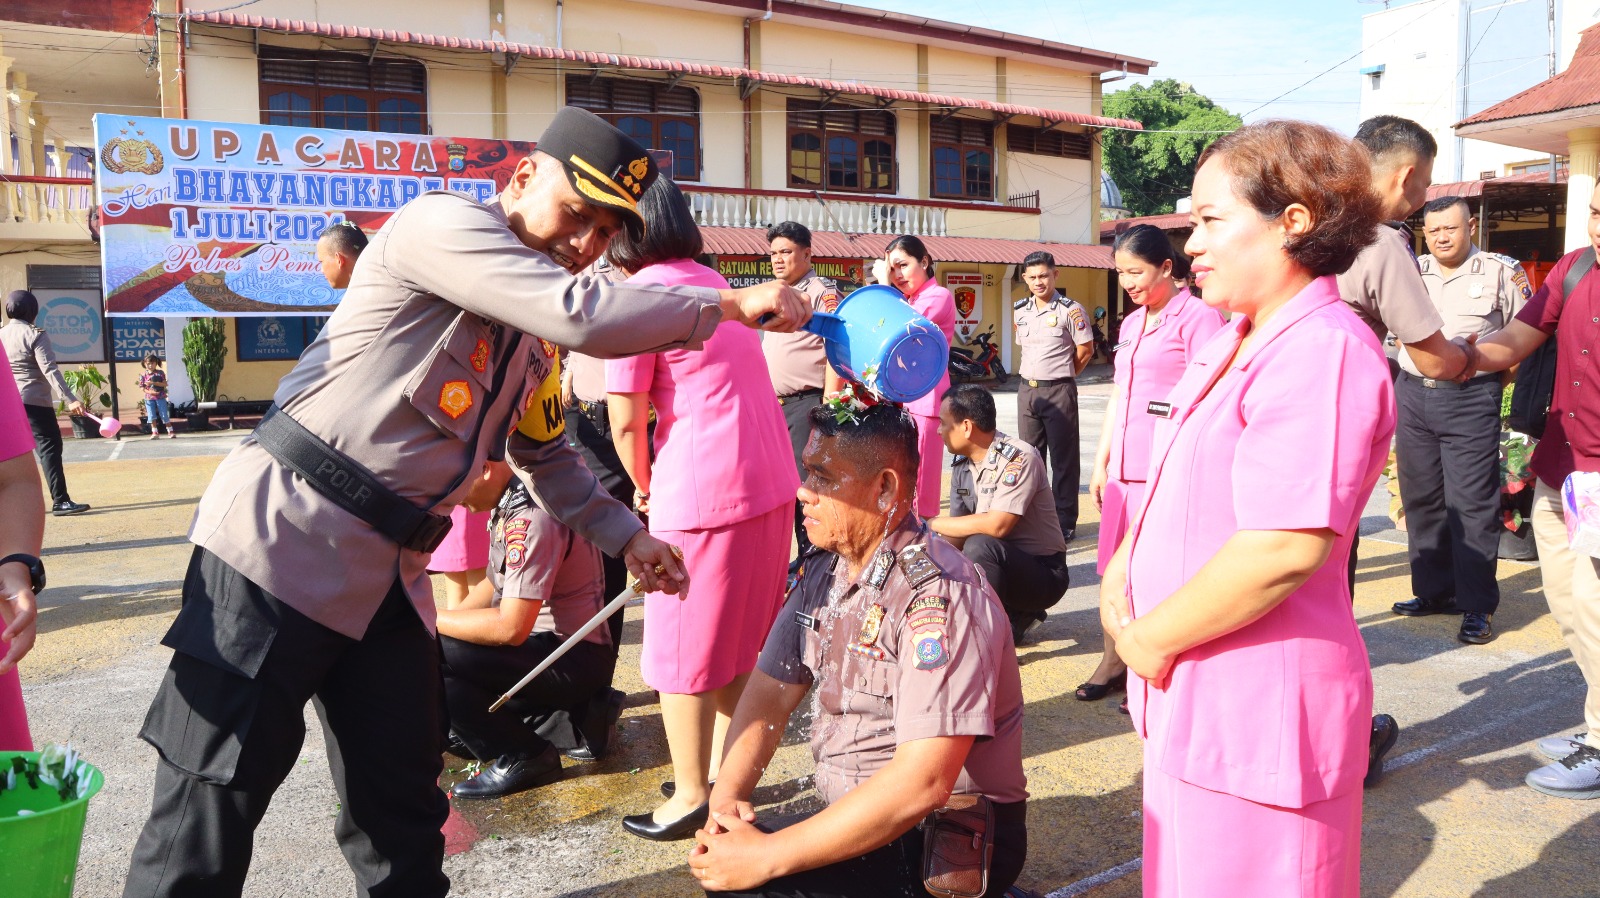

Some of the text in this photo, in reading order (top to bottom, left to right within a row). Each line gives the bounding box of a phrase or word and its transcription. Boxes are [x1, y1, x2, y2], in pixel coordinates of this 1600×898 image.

[170, 126, 438, 171] UPACARA
[103, 181, 171, 215] Hari
[173, 210, 344, 241] 1 JULI 202
[165, 244, 242, 271] Polres
[720, 261, 757, 276] SATUAN
[728, 278, 759, 287] POLRES
[46, 315, 91, 327] STOP
[113, 328, 164, 339] TURN
[114, 350, 166, 358] CRIME
